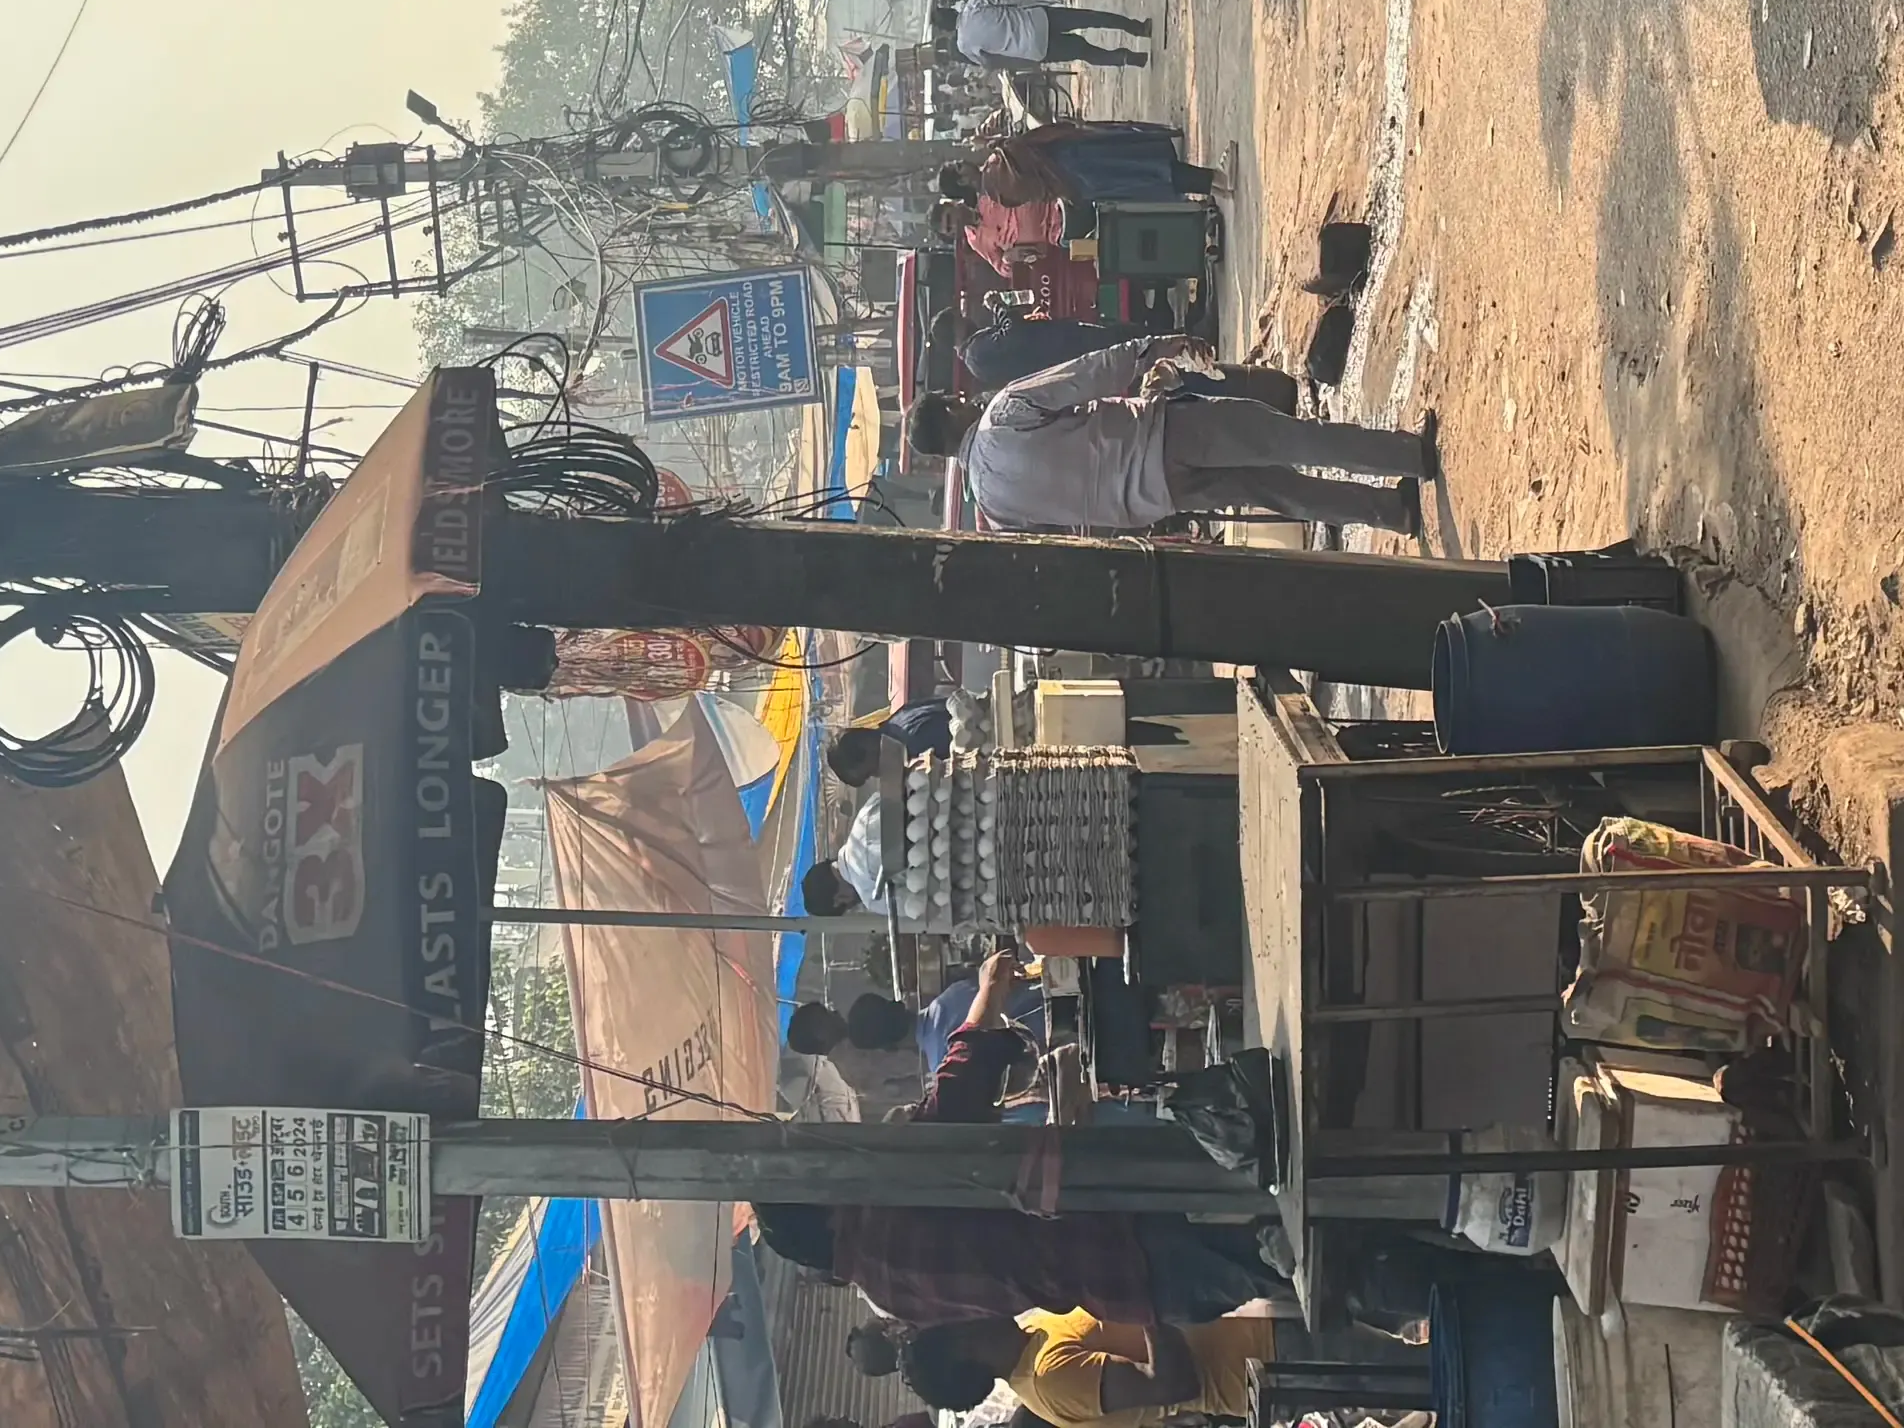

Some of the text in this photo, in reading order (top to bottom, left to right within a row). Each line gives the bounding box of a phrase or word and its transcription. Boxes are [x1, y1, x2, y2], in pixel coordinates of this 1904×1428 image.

[729, 292, 748, 392] MOTOR VEHICLE
[743, 282, 762, 396] RESTRICTED ROAD
[760, 316, 773, 358] AHEAD
[769, 280, 793, 391] 9AM TO 9PM
[436, 387, 478, 480] MORE
[258, 758, 285, 953] DANGOTE
[293, 759, 355, 927] 3X
[416, 632, 462, 1032] LASTS LONGER
[219, 1191, 230, 1219] SOUTH
[287, 1117, 306, 1226] 4 5 6 2024
[412, 1274, 445, 1378] SETS
